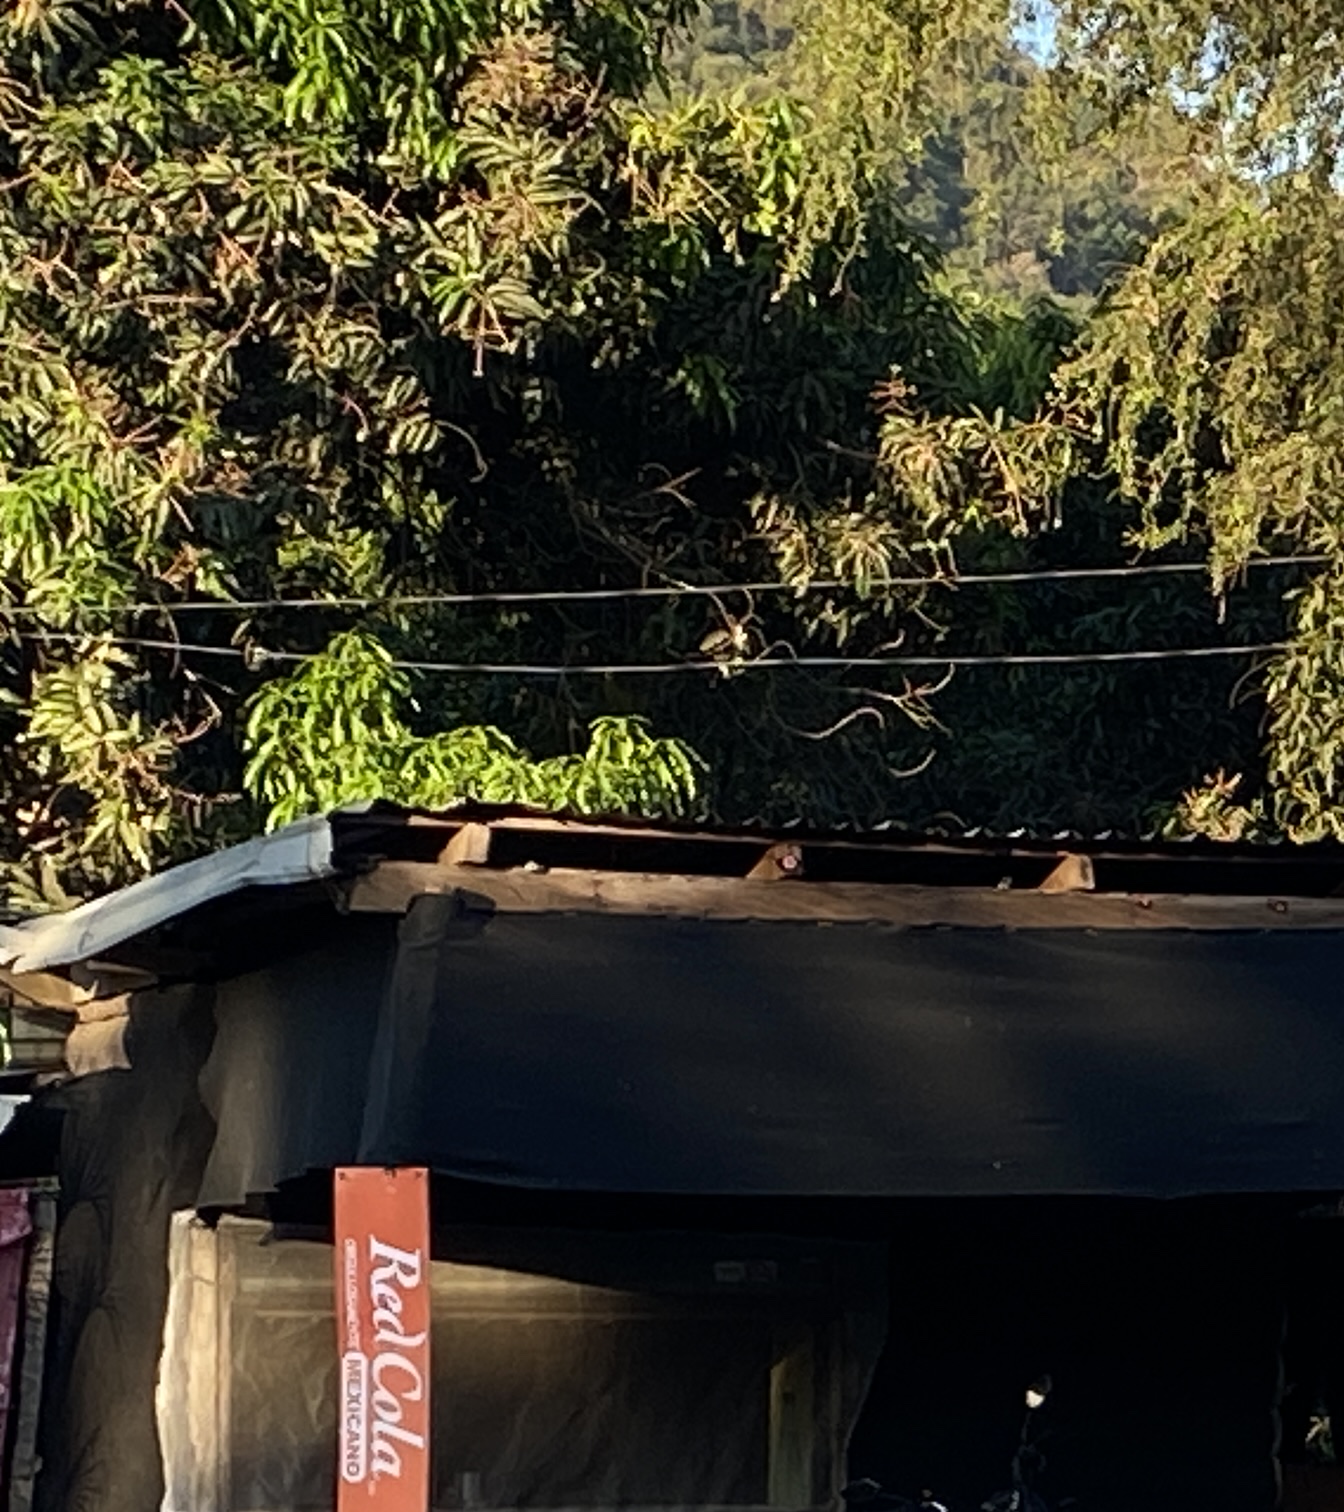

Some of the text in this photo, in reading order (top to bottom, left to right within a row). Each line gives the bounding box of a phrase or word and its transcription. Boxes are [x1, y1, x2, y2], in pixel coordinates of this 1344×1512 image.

[346, 1359, 361, 1476] MEXICANO
[370, 1235, 425, 1477] Red Cola
